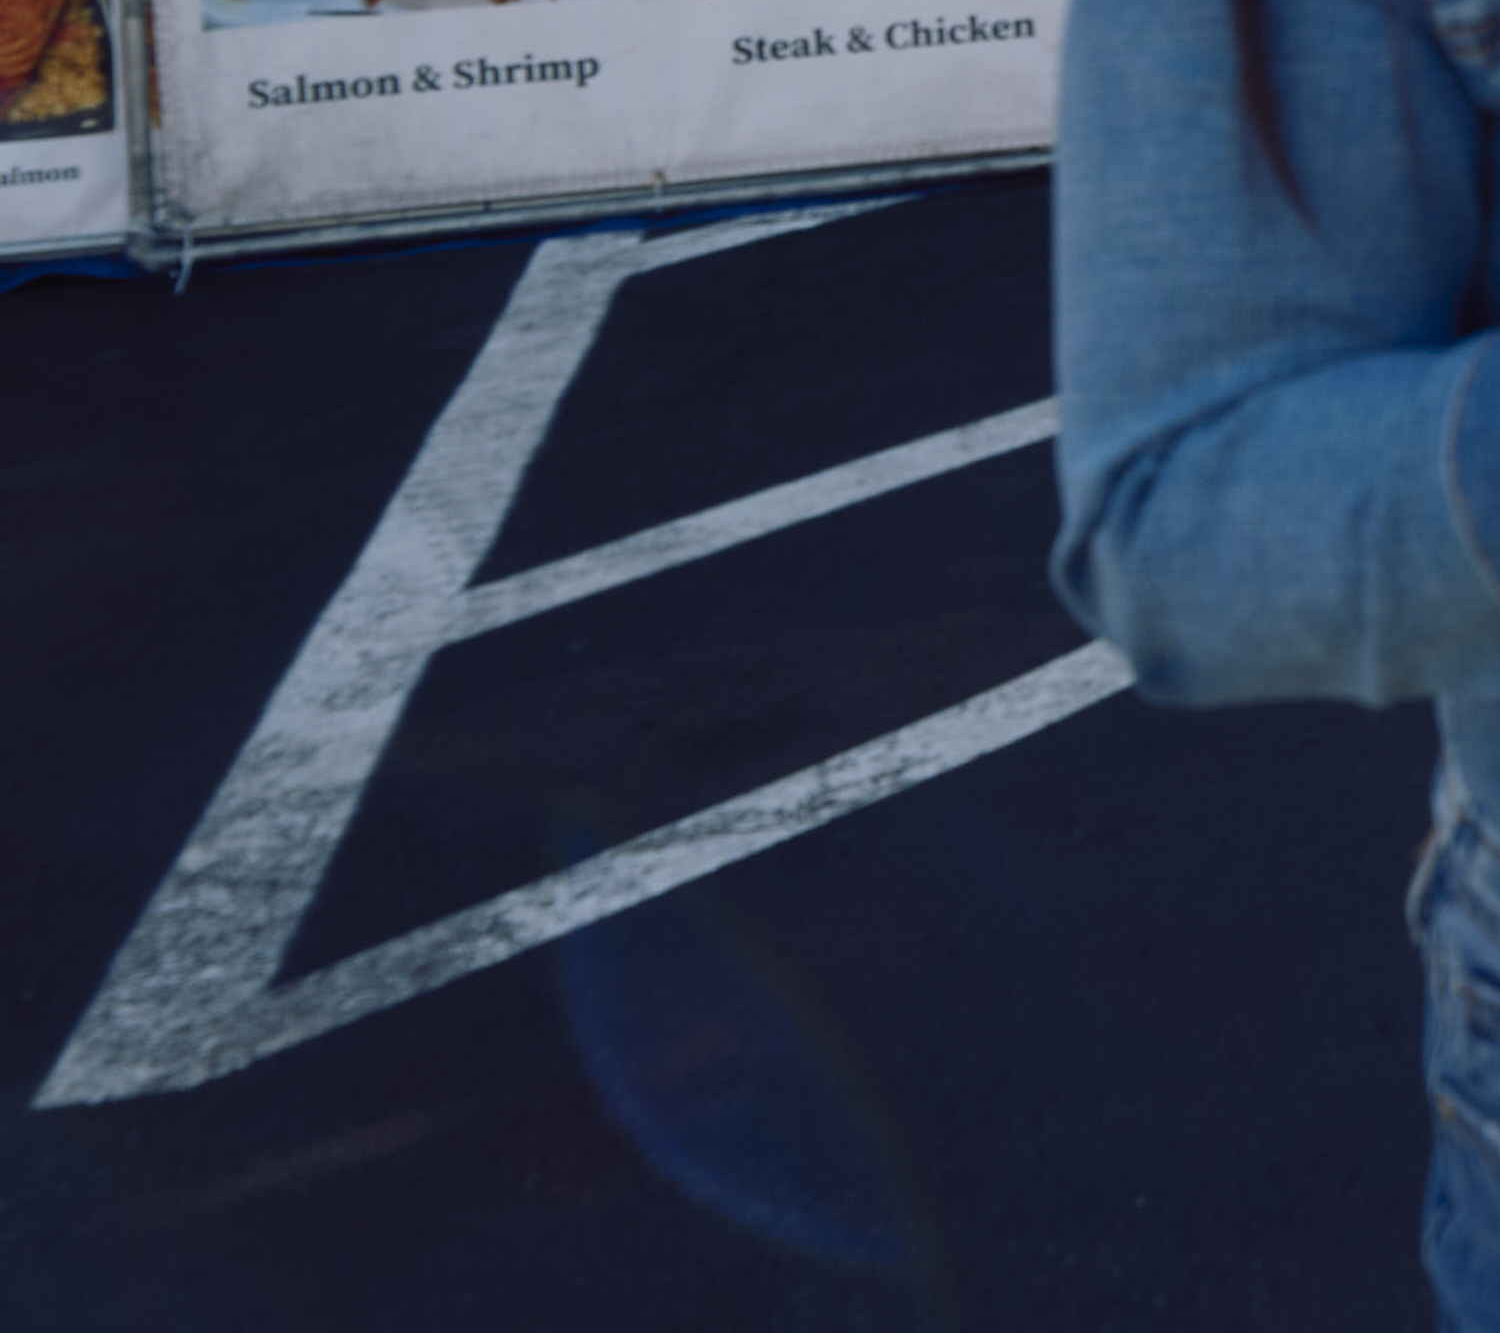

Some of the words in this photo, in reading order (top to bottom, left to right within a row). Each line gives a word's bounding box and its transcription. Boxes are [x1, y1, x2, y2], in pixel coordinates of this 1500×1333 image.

[731, 27, 837, 66] Steak
[845, 26, 875, 54] &
[883, 14, 1036, 51] Chicken
[247, 73, 402, 110] Salmon
[411, 64, 443, 94] &
[452, 53, 601, 90] Shrimp
